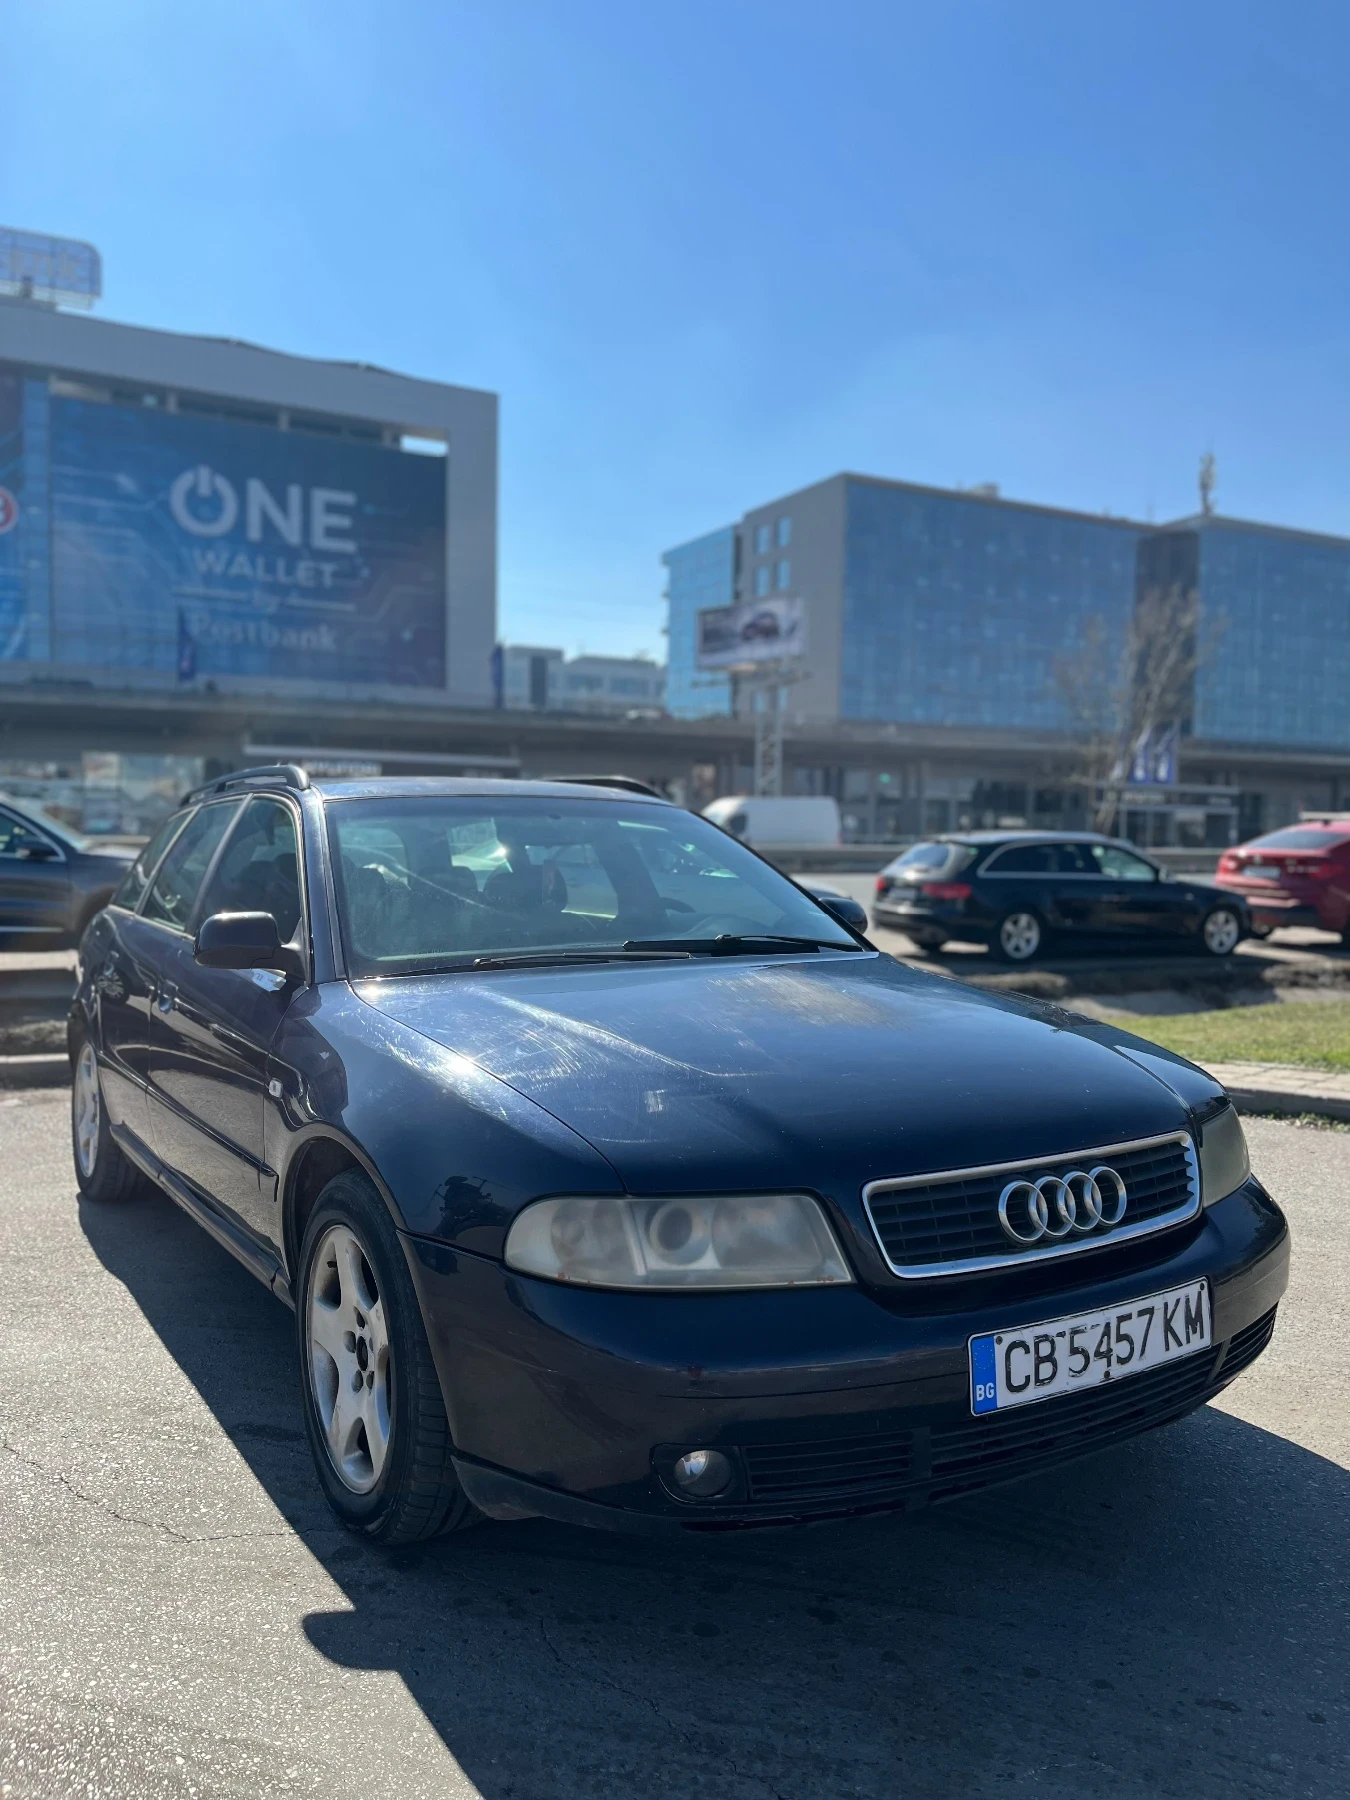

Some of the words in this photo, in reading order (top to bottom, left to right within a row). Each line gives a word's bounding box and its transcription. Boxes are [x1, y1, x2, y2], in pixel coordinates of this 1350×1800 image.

[171, 466, 356, 554] ONE
[194, 549, 337, 588] WALLET
[189, 612, 337, 652] Postbank
[976, 1383, 995, 1402] BG
